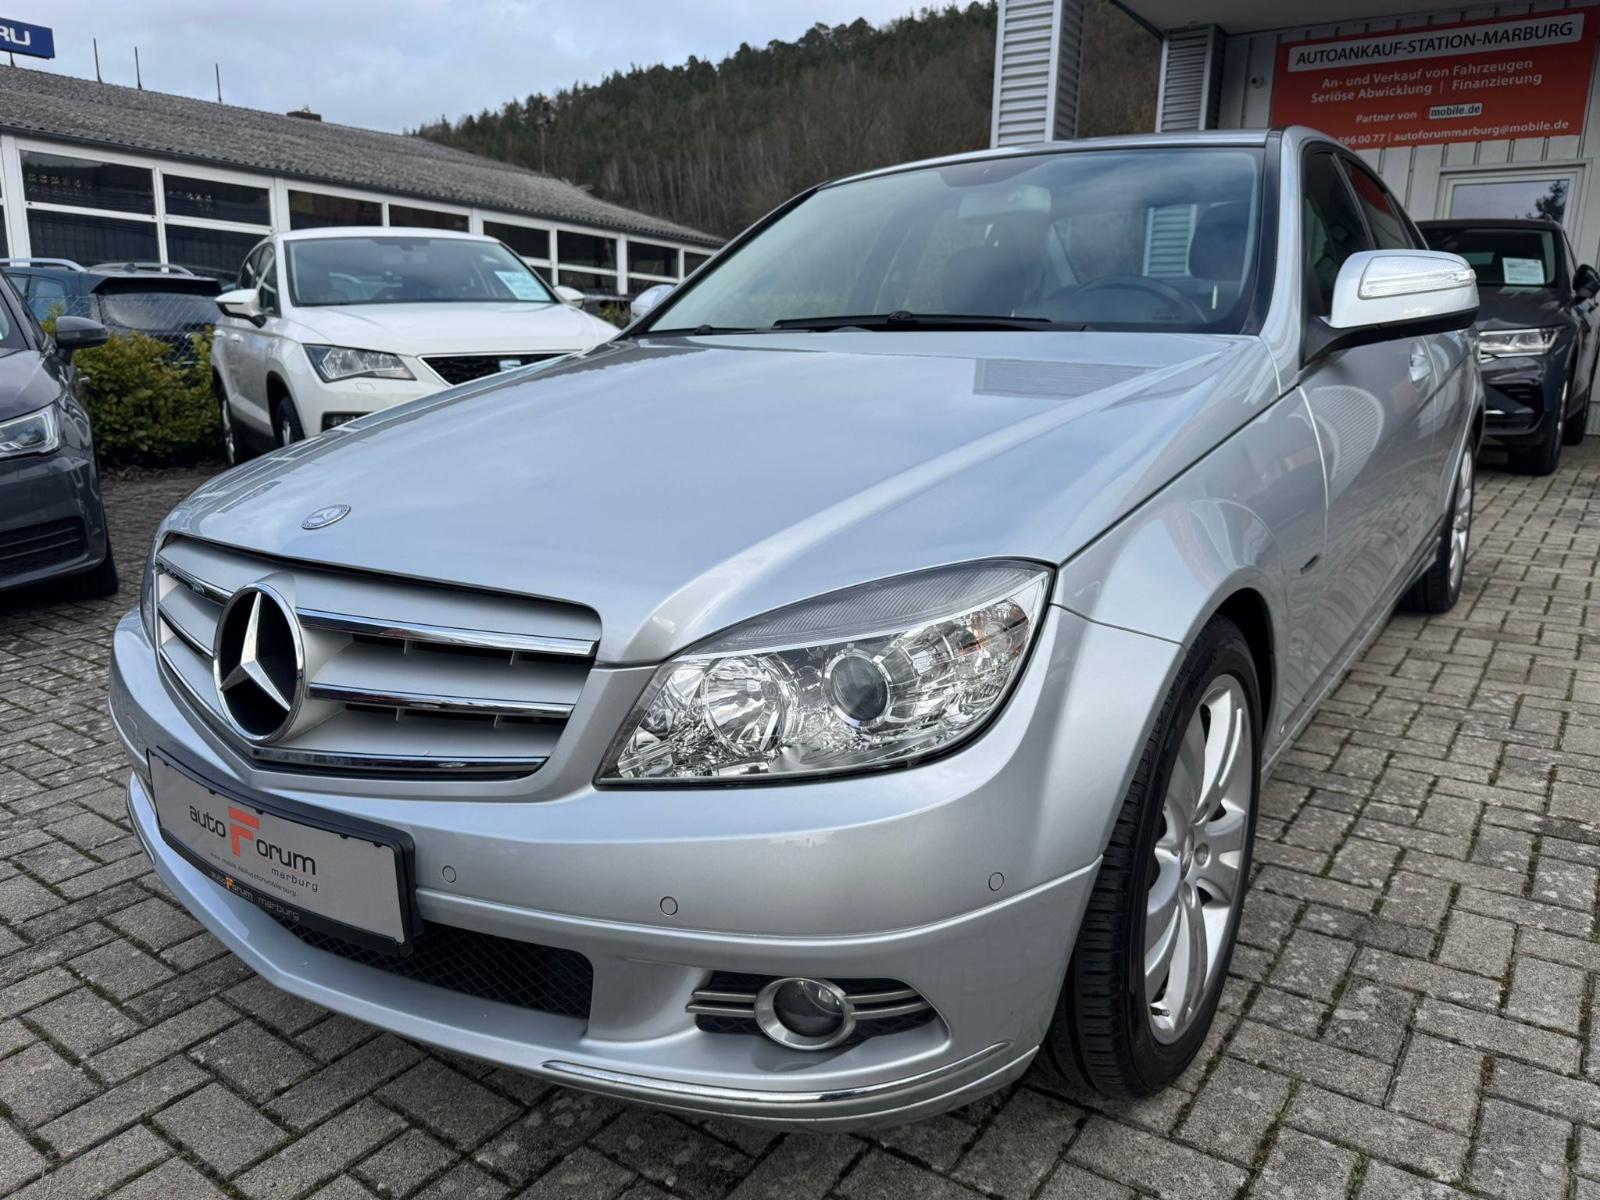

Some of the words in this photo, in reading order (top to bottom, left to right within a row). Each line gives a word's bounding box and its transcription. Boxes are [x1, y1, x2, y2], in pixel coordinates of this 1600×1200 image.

[1296, 22, 1573, 65] AUTOANKAUF-STATION-MARBURG
[1322, 77, 1342, 89] An-
[1346, 74, 1370, 86] und
[1373, 69, 1423, 84] Verkauf
[1425, 69, 1449, 78] von
[1453, 60, 1533, 76] Fahrzeugen
[1311, 91, 1355, 104] Seriöse
[1358, 84, 1433, 99] Abwicklung
[1452, 73, 1542, 90] Finanzierung
[1356, 113, 1395, 124] Partner
[1397, 112, 1417, 120] von
[1431, 104, 1481, 117] mobile.de
[1394, 120, 1569, 141] autoforummarburg@mobile.de
[271, 868, 318, 892] marburg
